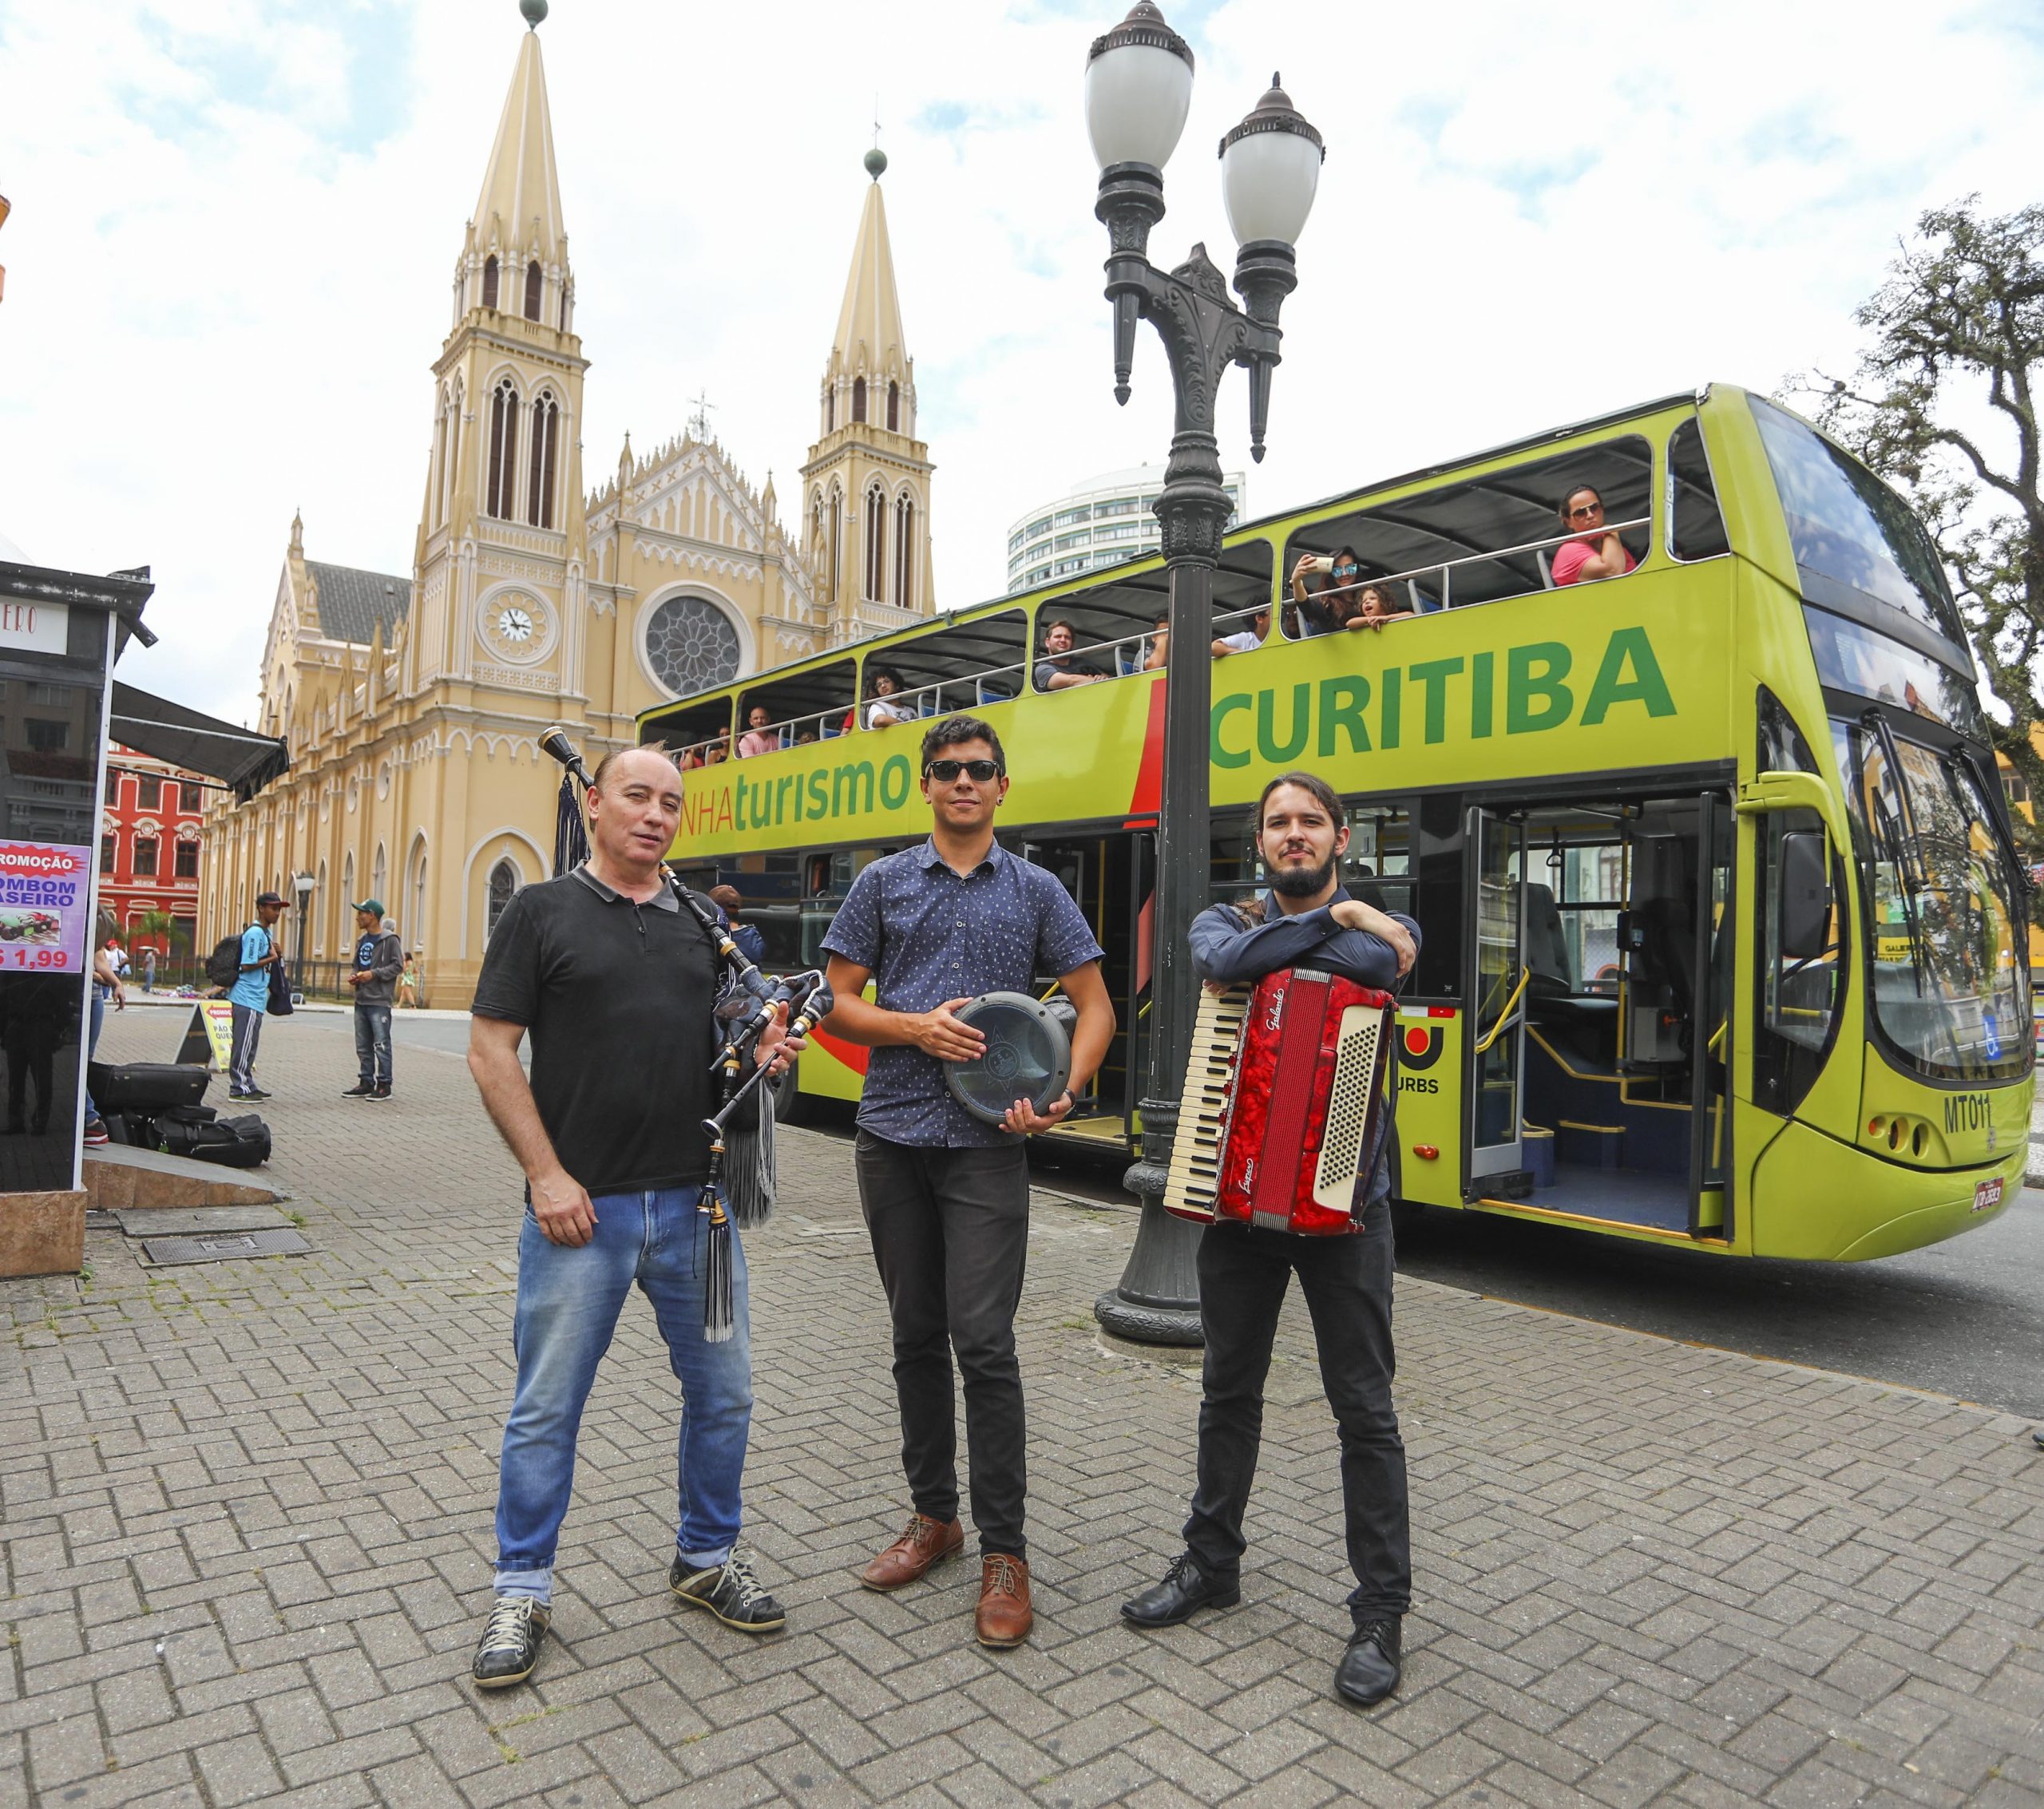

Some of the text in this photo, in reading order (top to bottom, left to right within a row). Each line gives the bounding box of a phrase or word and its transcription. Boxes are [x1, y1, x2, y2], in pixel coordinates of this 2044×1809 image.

[1210, 626, 1678, 769] CURITIBA
[14, 949, 68, 970] 1,99
[1943, 1093, 1991, 1134] MT011
